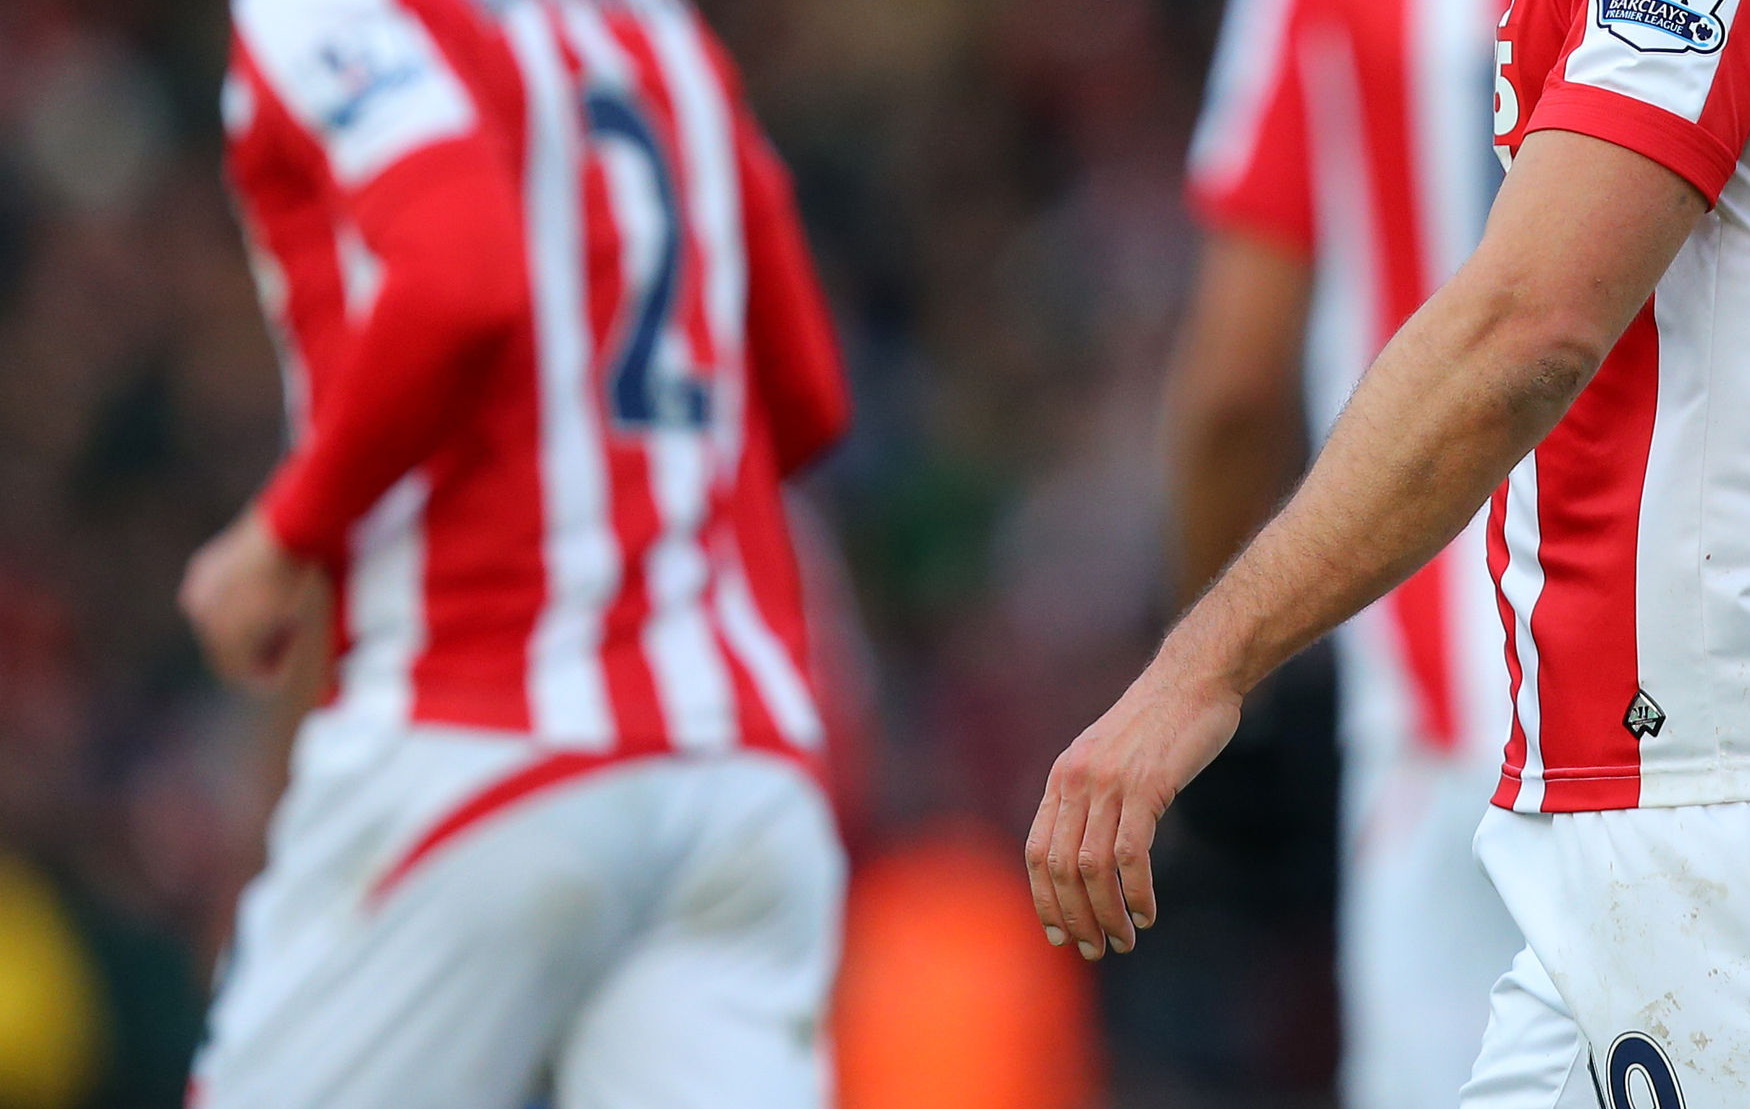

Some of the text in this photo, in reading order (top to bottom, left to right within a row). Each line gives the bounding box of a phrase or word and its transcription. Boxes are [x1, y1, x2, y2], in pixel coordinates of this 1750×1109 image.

[1605, 9, 1684, 34] PREMIER LEAGUE
[580, 85, 712, 430] 2
